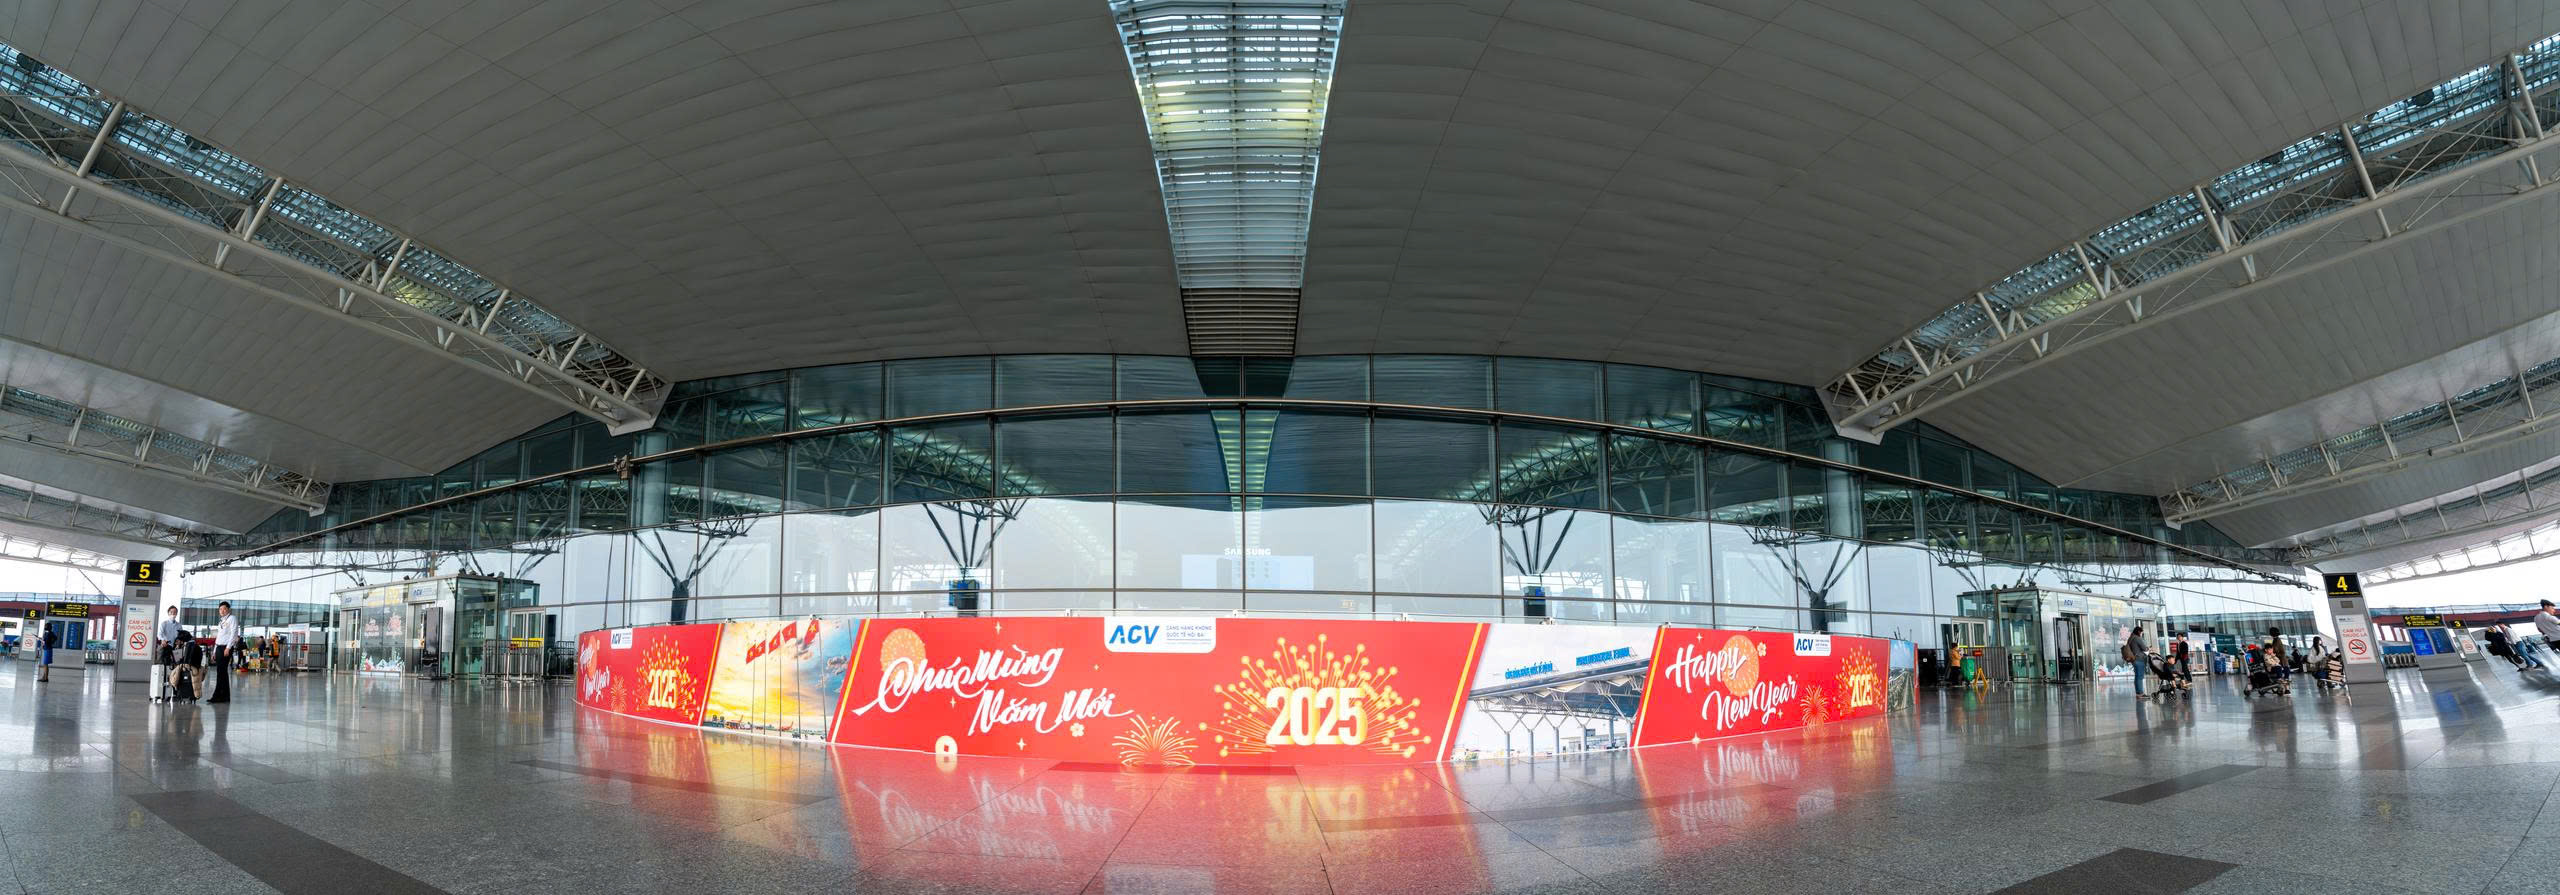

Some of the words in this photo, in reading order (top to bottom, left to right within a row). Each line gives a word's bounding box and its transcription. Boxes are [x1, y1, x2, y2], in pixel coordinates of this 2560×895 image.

[139, 564, 150, 579] 5
[2337, 576, 2348, 591] 4
[1109, 625, 1160, 644] ACV
[1796, 639, 1814, 651] ACV
[852, 656, 988, 716] Chúc
[971, 644, 1064, 688] Mừng
[1665, 644, 1747, 693] Happy
[648, 669, 678, 709] 2025
[1702, 688, 1754, 731] New
[1752, 675, 1797, 725] Year
[1849, 674, 1873, 708] 2025
[967, 689, 1063, 736] Năm
[1055, 687, 1135, 725] Mới
[1265, 686, 1368, 746] 2025
